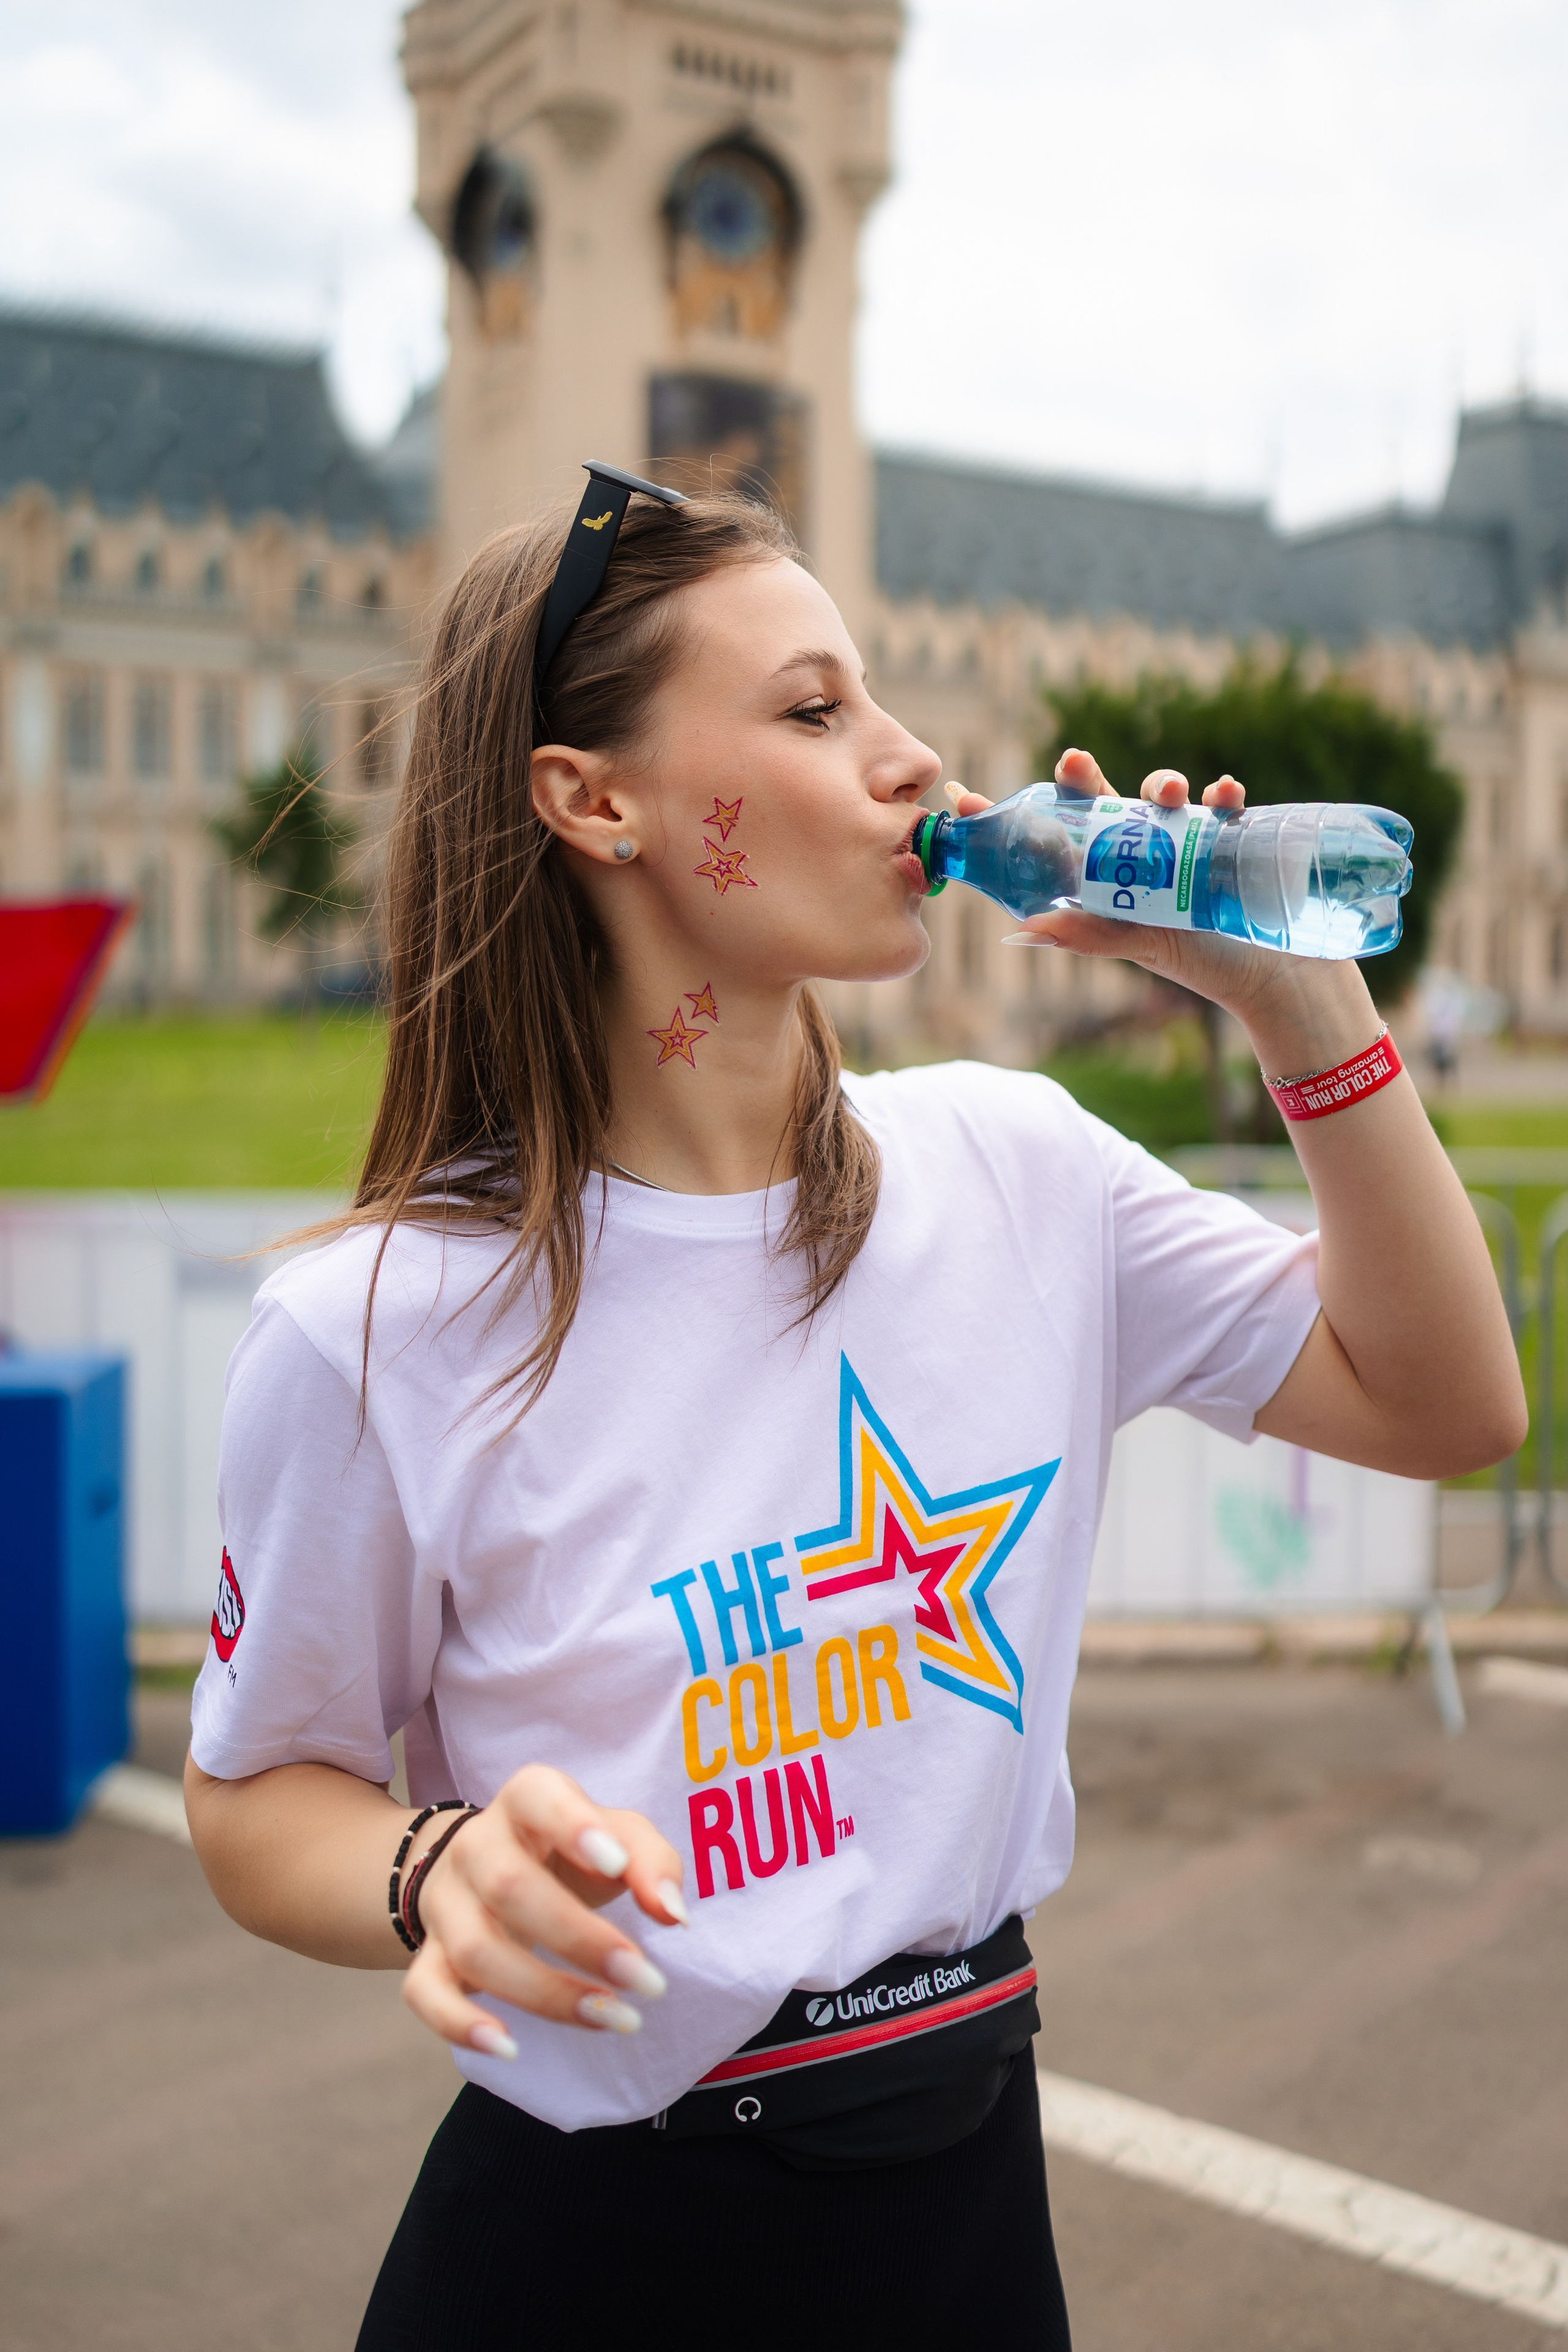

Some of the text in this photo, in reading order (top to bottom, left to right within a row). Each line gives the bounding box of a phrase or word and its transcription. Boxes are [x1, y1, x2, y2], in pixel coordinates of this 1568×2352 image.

[1113, 805, 1153, 910] DORNA
[1180, 841, 1194, 908] NECARBOGAZOASĂ
[1305, 1056, 1392, 1110] THE COLOR RUN
[1317, 1051, 1378, 1090] amazing tour
[650, 1540, 803, 1677] THE
[227, 1664, 237, 1687] FM
[680, 1624, 911, 1783] COLOR
[687, 1754, 854, 1899] RUN TM
[836, 1959, 976, 2021] UniCredit Bank
